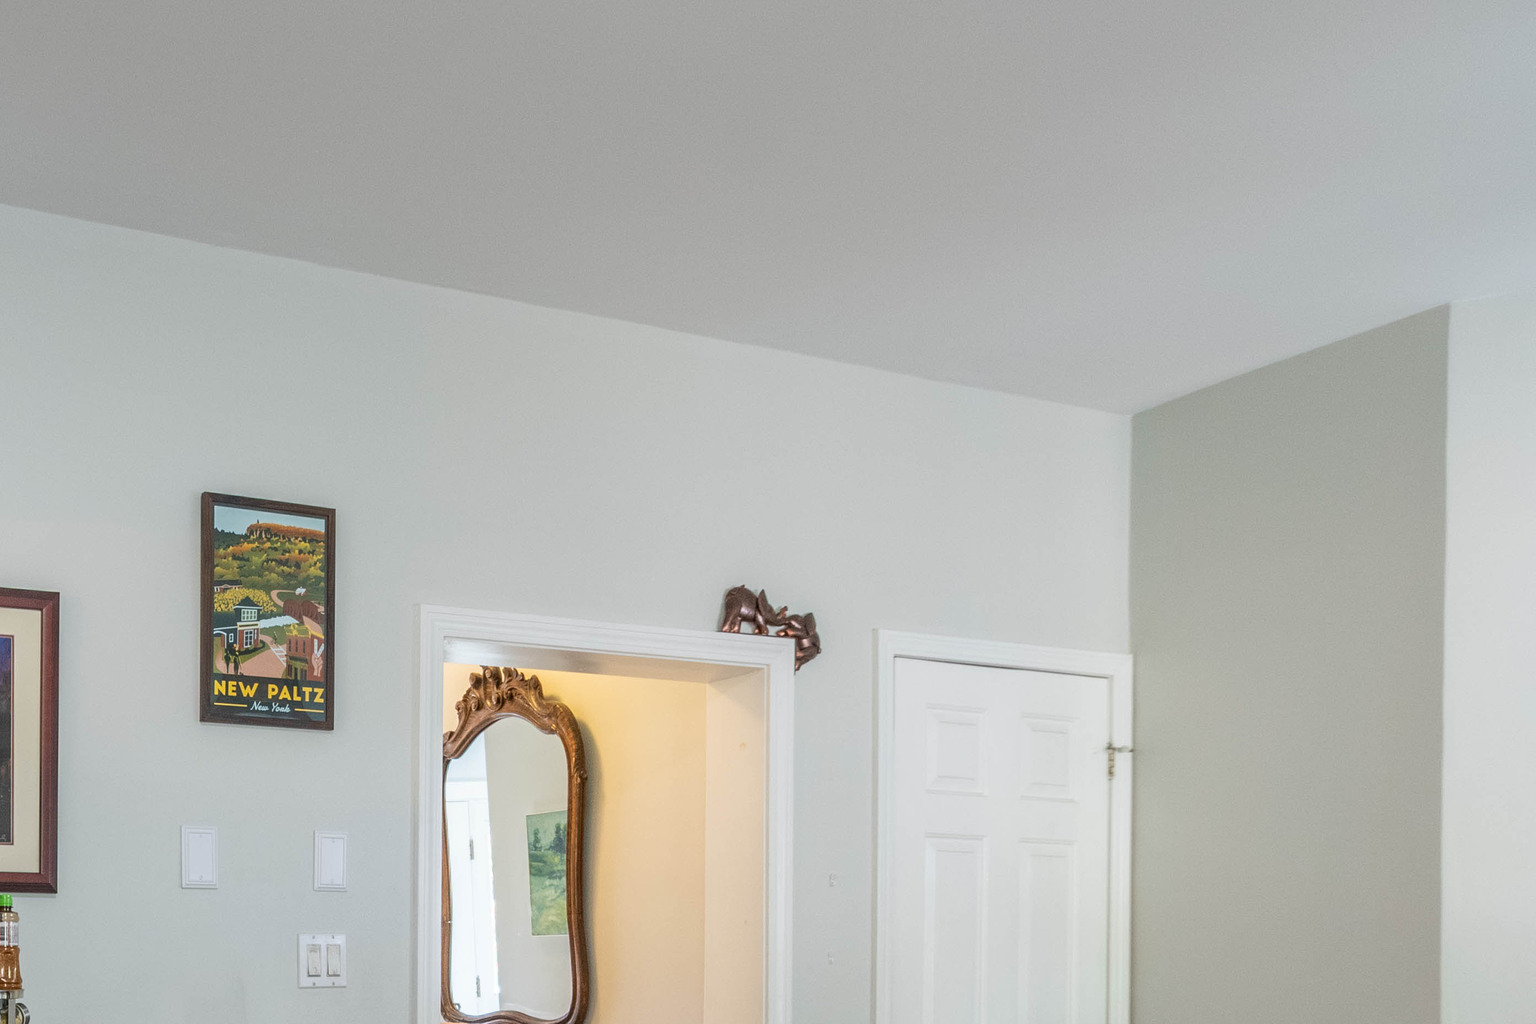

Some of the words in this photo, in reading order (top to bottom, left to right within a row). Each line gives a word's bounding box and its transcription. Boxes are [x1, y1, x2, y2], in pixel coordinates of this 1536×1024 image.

[214, 680, 259, 698] NEW
[267, 683, 324, 703] PALTZ
[250, 700, 269, 711] New
[271, 702, 291, 713] York
